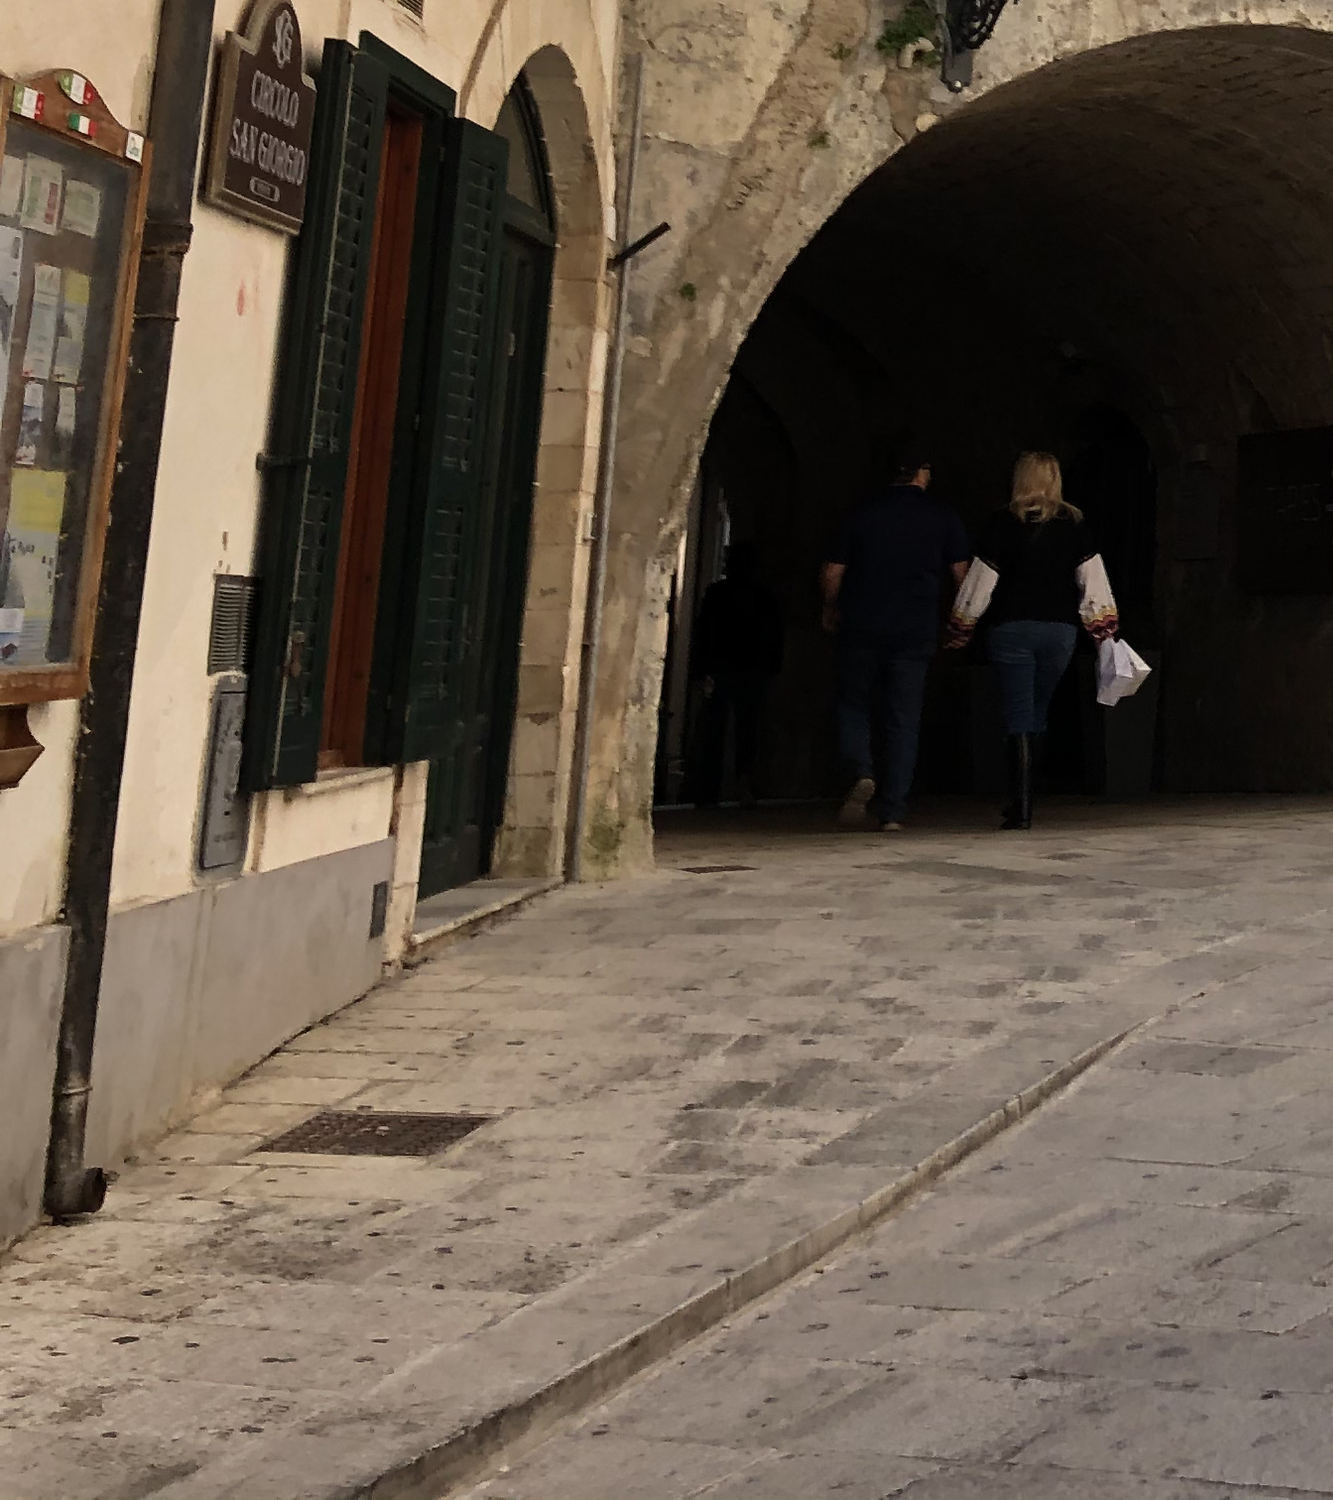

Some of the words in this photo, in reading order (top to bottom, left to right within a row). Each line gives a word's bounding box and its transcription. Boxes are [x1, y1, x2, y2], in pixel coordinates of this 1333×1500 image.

[251, 69, 299, 129] CIRCOLO
[229, 118, 259, 165] SAN
[258, 132, 306, 186] GIORGIO
